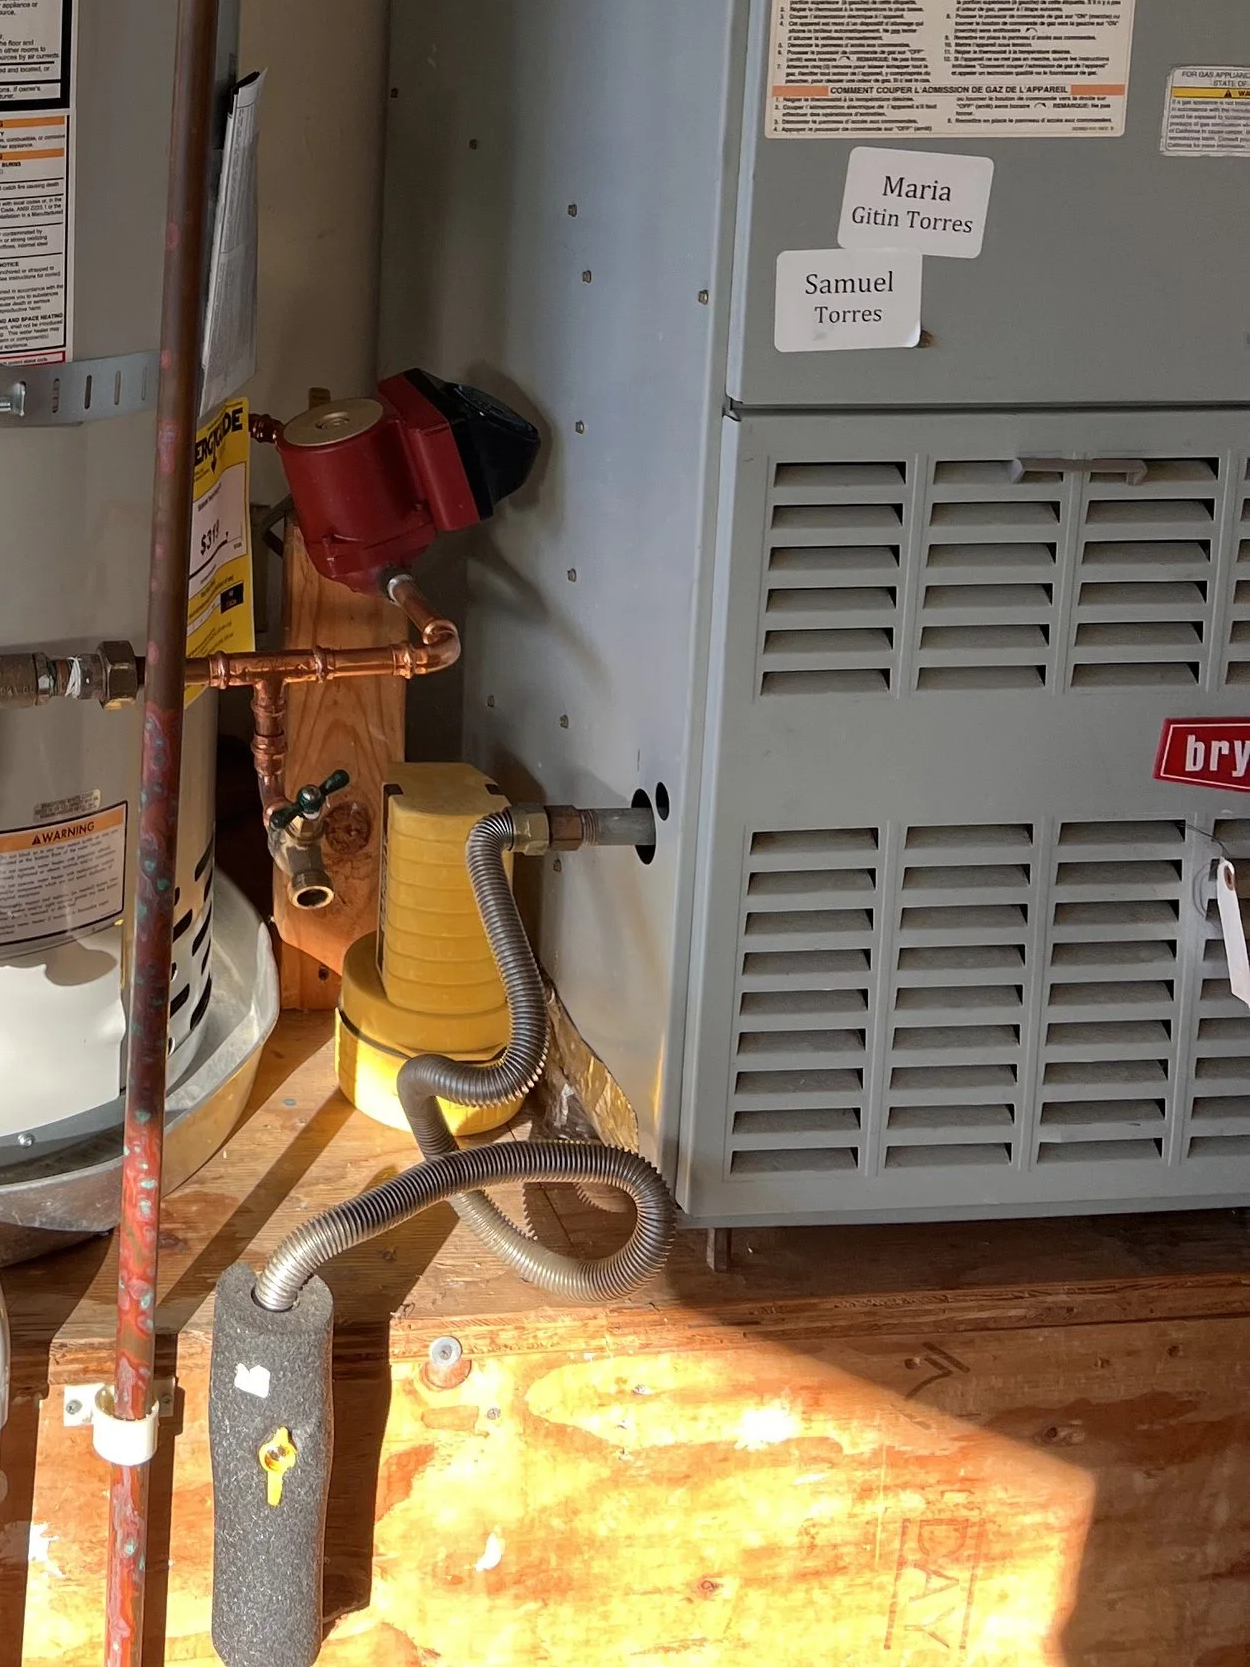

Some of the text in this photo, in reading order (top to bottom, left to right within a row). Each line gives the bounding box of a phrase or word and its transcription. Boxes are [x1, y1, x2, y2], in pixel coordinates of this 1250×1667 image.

[829, 85, 1068, 94] COMMENT COUPER L'ADMISSION DE GAZ DE L'APPAREIL
[882, 175, 950, 201] Maria
[851, 205, 973, 233] Gitin Torres
[805, 270, 893, 294] Samuel
[40, 312, 63, 320] HEATING
[814, 305, 882, 323] Torres
[1185, 734, 1250, 777] bry
[41, 820, 94, 844] WARNING
